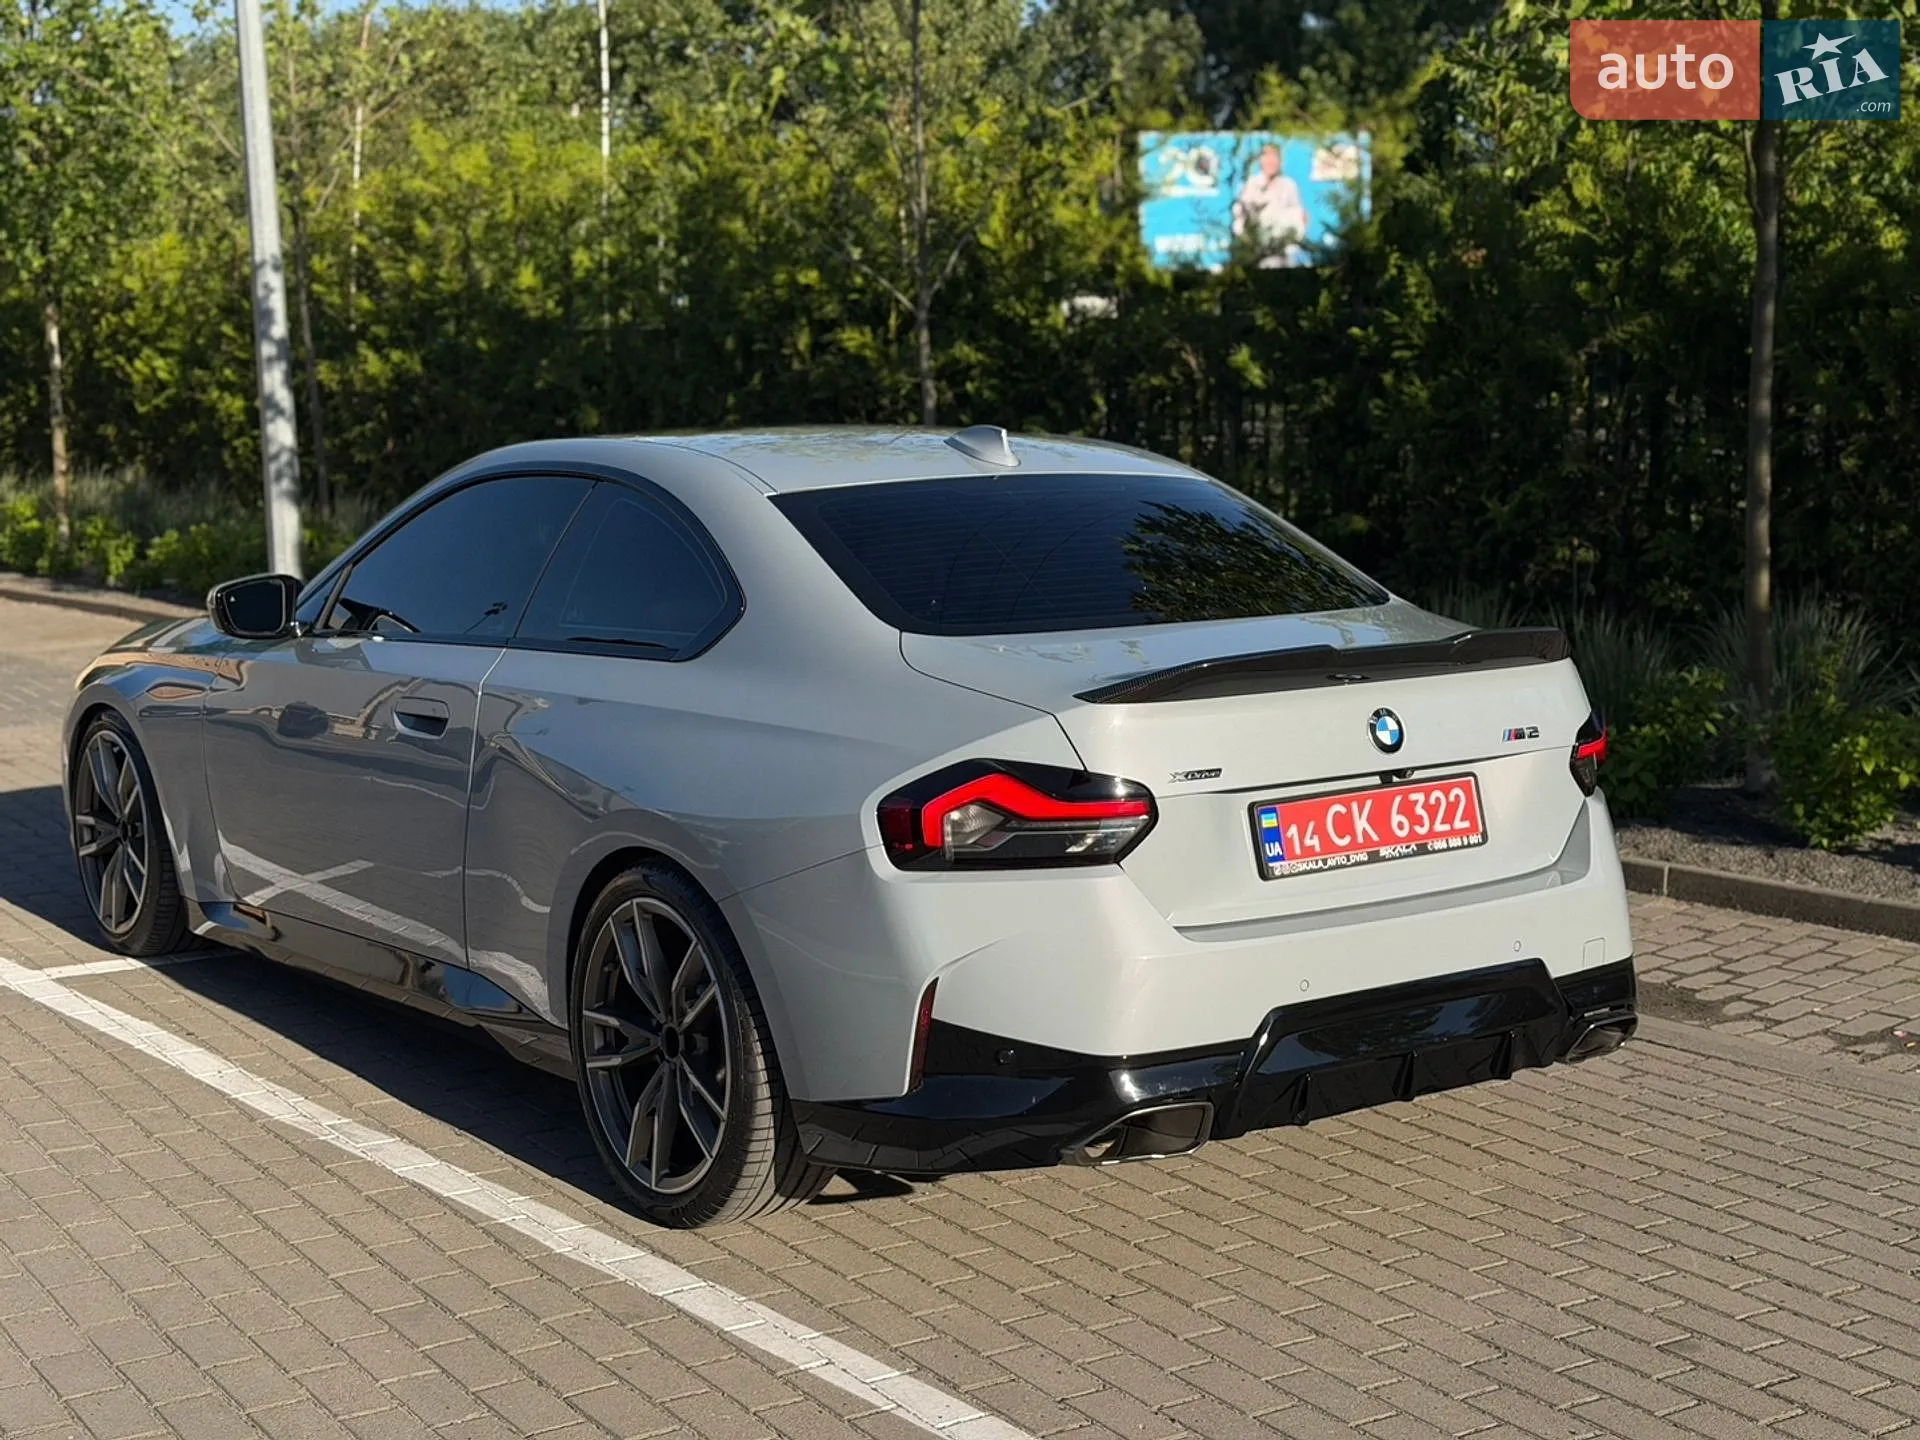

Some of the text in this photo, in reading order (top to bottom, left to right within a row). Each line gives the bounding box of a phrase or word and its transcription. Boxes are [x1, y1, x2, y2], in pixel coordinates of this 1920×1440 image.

[1286, 787, 1471, 855] 14 CK 6322
[1266, 841, 1283, 857] UA
